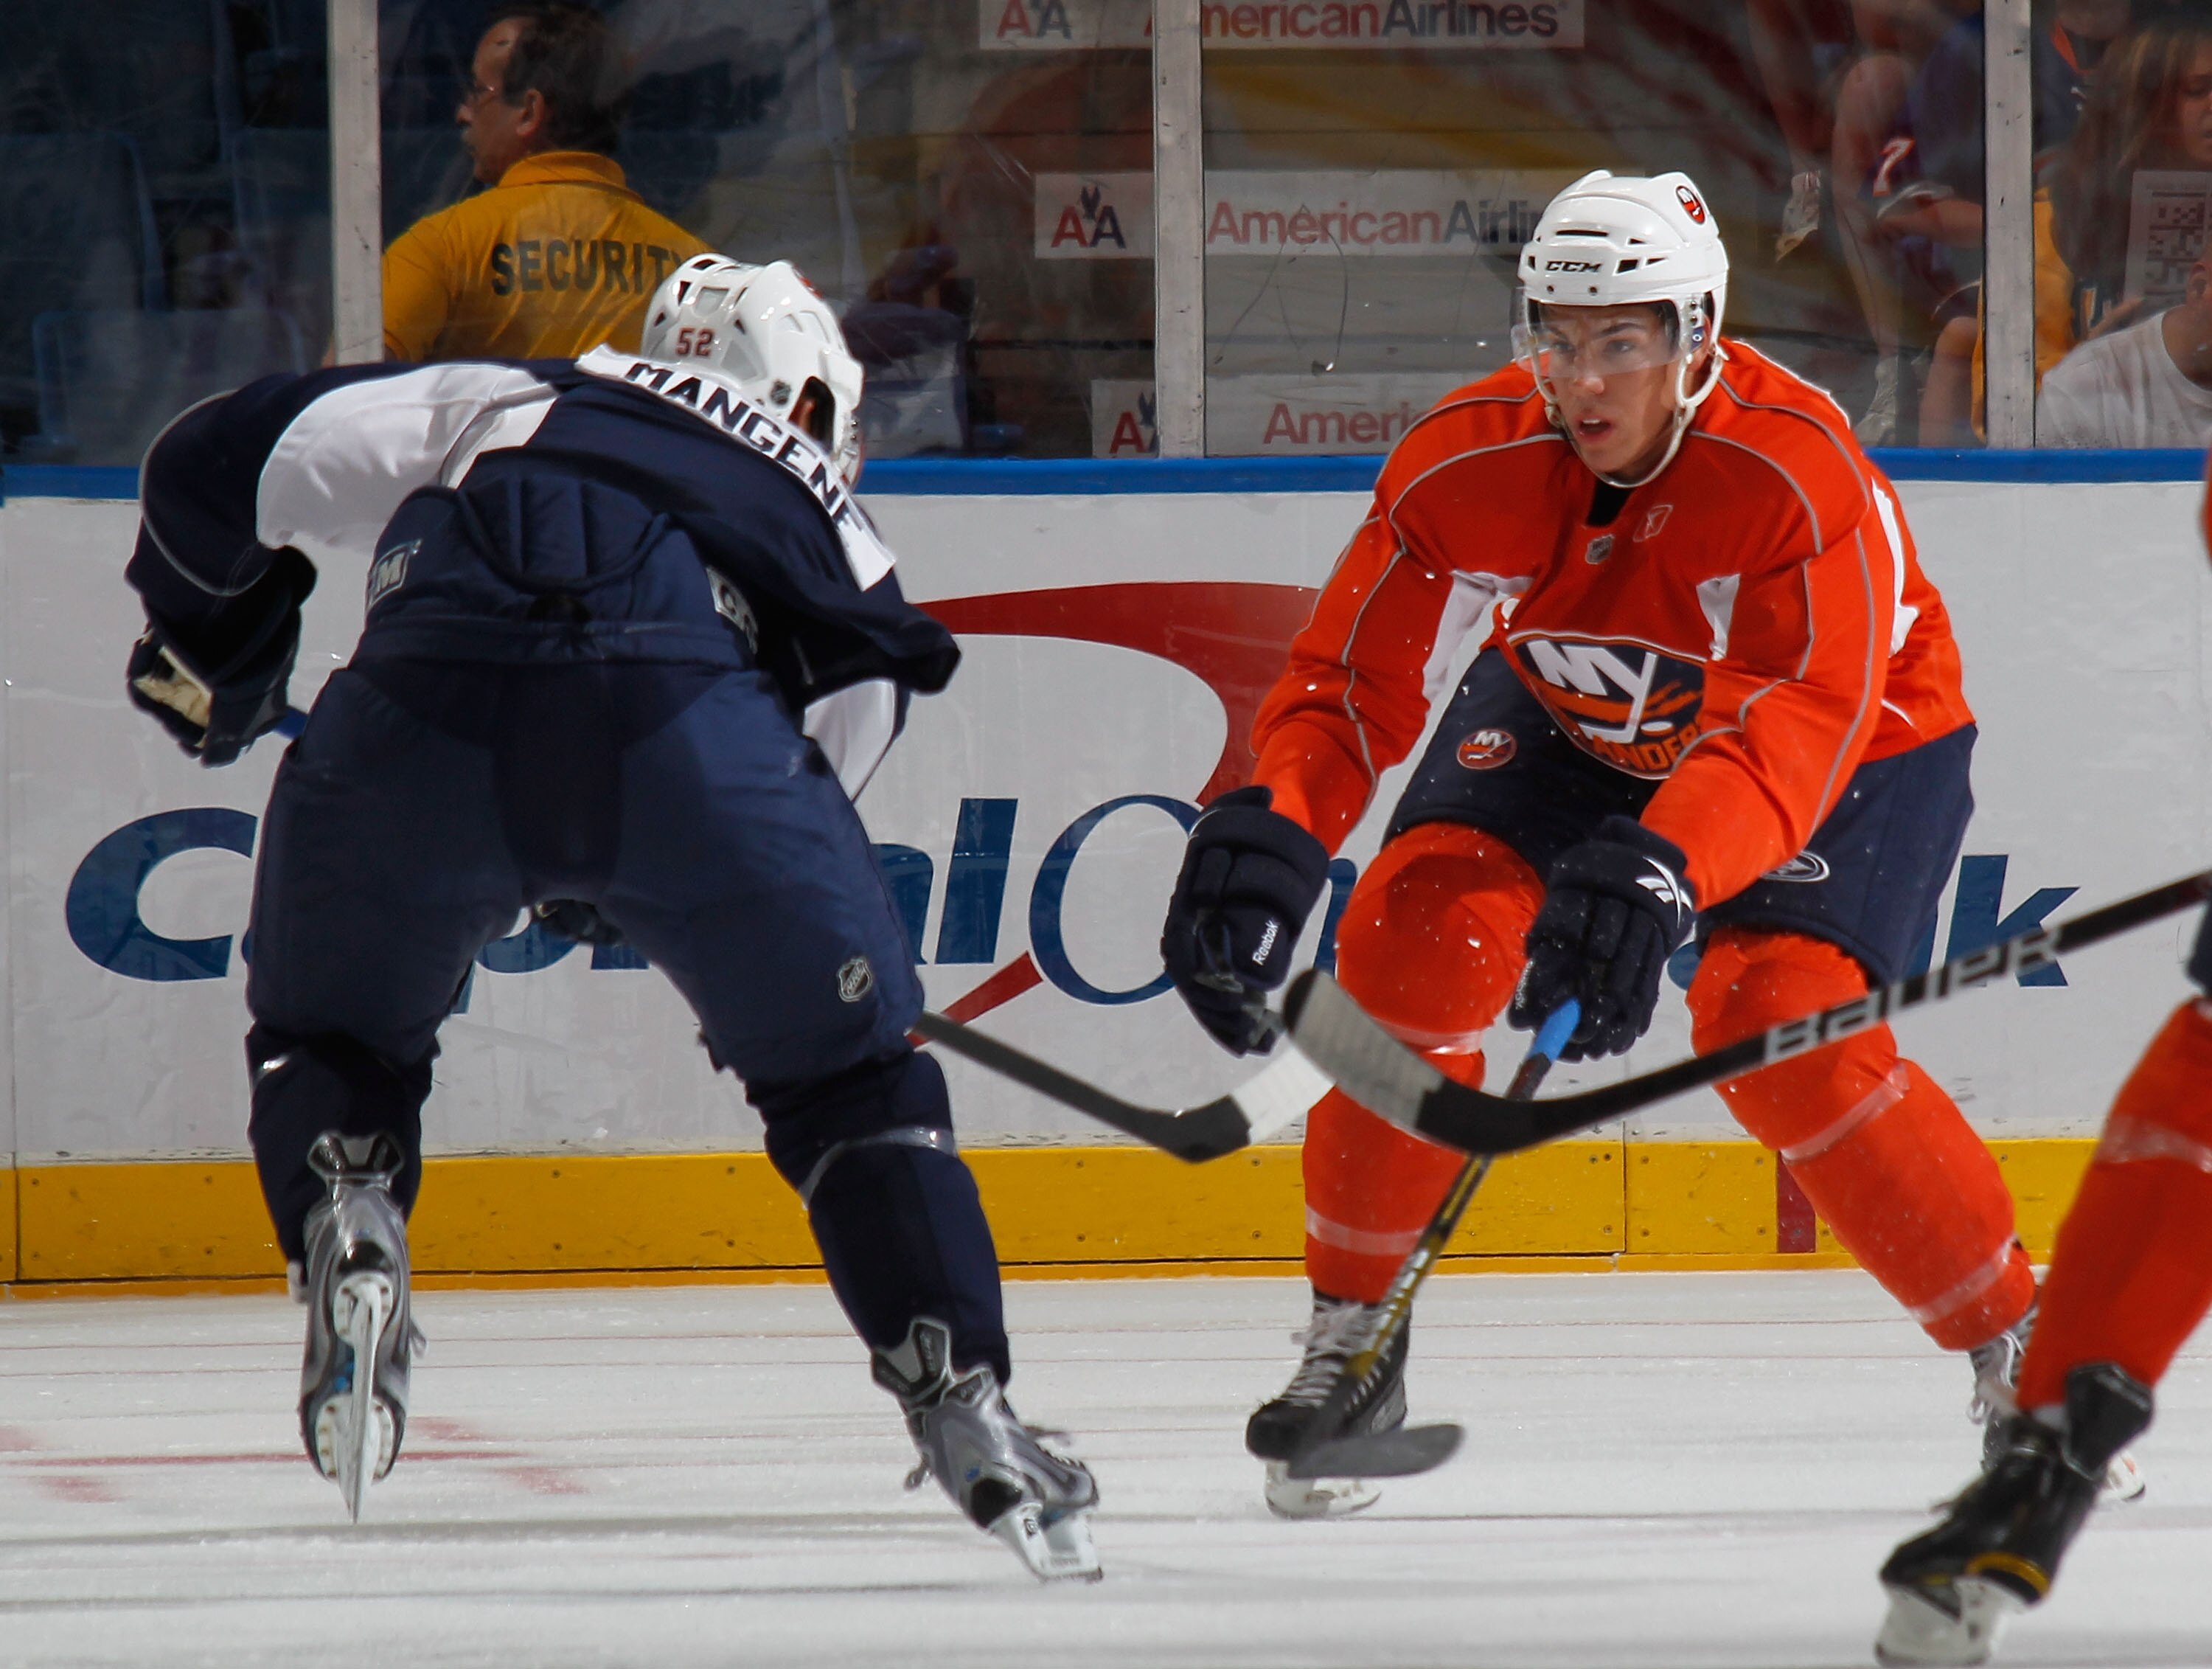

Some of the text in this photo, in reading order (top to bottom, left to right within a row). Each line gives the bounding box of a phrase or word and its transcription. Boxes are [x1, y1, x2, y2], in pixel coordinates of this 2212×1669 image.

[996, 0, 1071, 39] AA
[1874, 139, 1915, 197] 7
[1051, 204, 1126, 249] AA
[492, 239, 681, 296] SECURIT
[1545, 260, 1602, 272] CCM
[675, 327, 714, 357] 52
[1109, 411, 1159, 454] A
[1263, 402, 1428, 444] Ameri
[1252, 920, 1278, 965] Reebok
